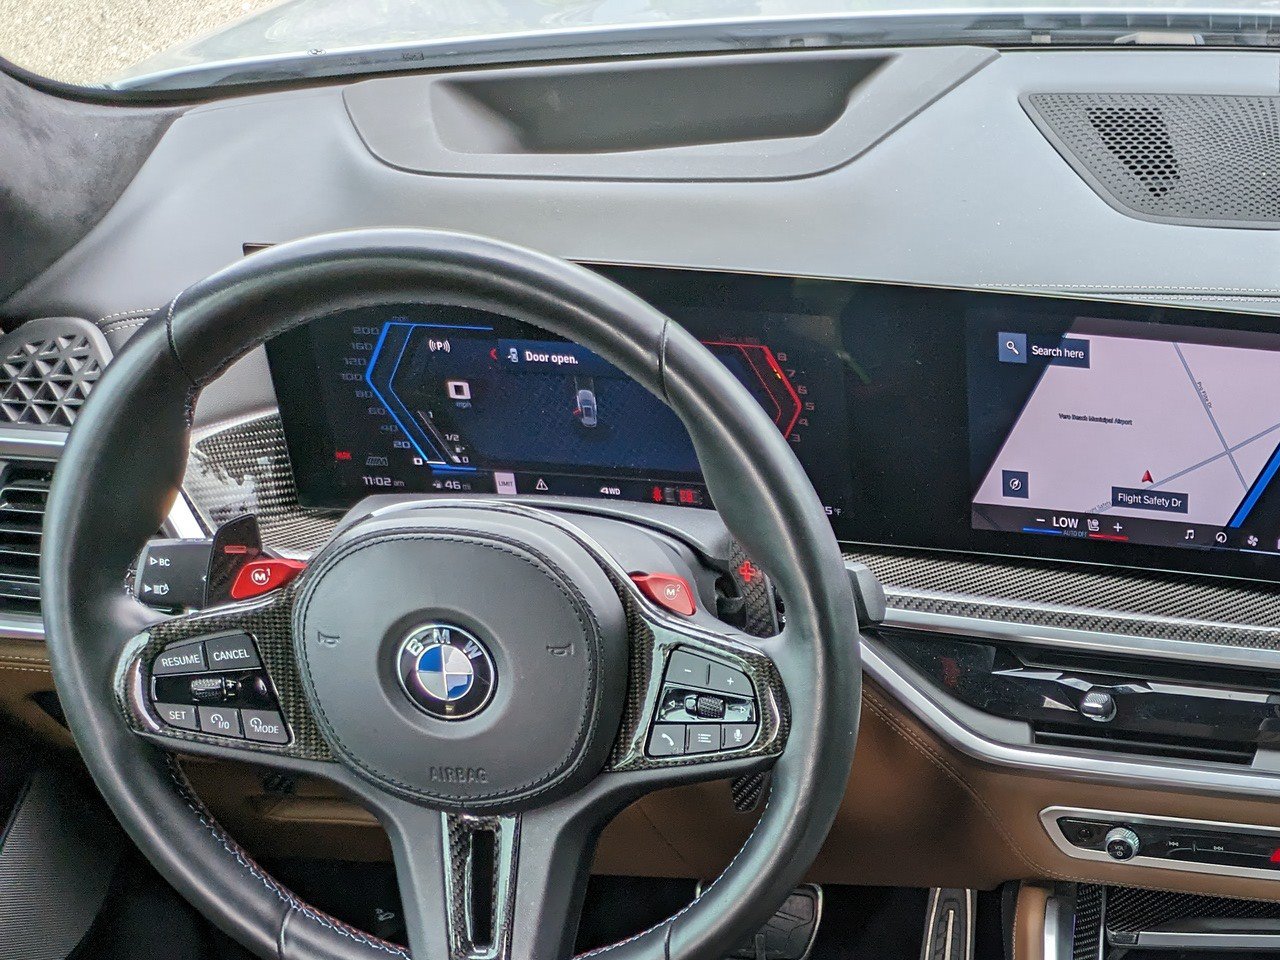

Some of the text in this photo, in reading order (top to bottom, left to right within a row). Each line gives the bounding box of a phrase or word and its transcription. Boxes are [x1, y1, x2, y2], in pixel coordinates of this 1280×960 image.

[525, 350, 579, 365] Door open.
[1031, 345, 1085, 359] Search here
[447, 381, 472, 400] 0
[445, 434, 460, 442] 1/2
[413, 457, 424, 466] 0
[362, 476, 393, 487] 11:02
[444, 481, 462, 490] 46
[600, 486, 621, 496] 4WD
[1118, 492, 1182, 508] Flight Safety Dr
[1053, 516, 1079, 529] LOW
[159, 558, 171, 566] BC
[405, 628, 483, 660] BMW
[161, 654, 201, 667] RESUME
[213, 649, 251, 661] CANCEL
[169, 710, 187, 720] SET
[254, 725, 280, 734] MODE
[429, 766, 489, 784] AIRBAG
